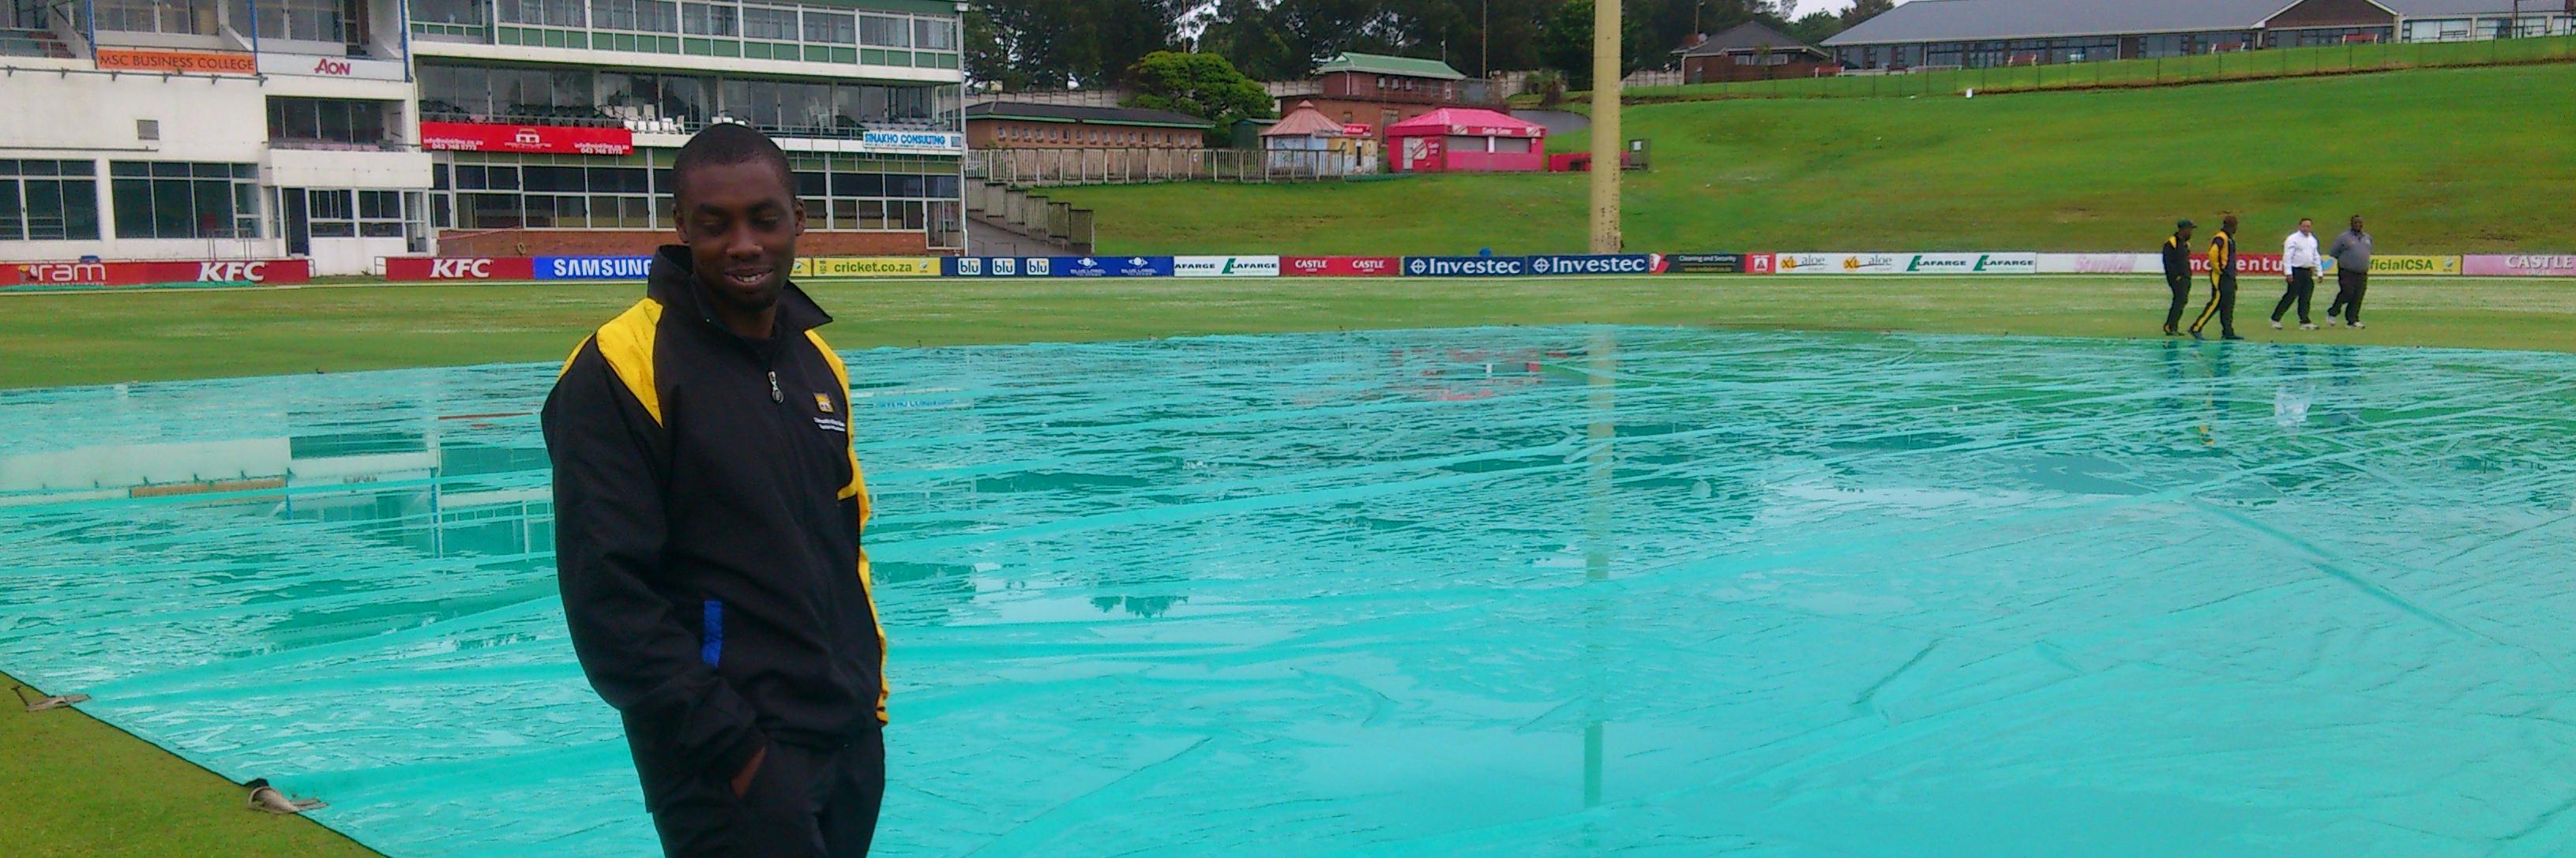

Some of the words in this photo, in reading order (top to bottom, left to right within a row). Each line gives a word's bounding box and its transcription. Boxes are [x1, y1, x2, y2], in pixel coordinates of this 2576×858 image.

[100, 54, 129, 66] MSC
[133, 55, 193, 68] BUSINESS
[197, 58, 254, 70] COLLEGE
[900, 134, 946, 145] CONSULTING
[834, 260, 912, 273] cricket.co.za
[960, 259, 979, 273] blu
[994, 259, 1013, 273] blu
[1029, 259, 1048, 273] blu
[1295, 260, 1327, 269] CASTLE
[1352, 260, 1384, 269] CASTLE
[1429, 258, 1521, 274] Investec
[1553, 257, 1646, 273] Investec
[1801, 254, 1826, 266] aloe
[1868, 254, 1892, 266] aloe
[2505, 255, 2575, 269] CASTLE
[39, 264, 106, 281] ram
[197, 262, 265, 282] KFC
[430, 259, 491, 278] KFC
